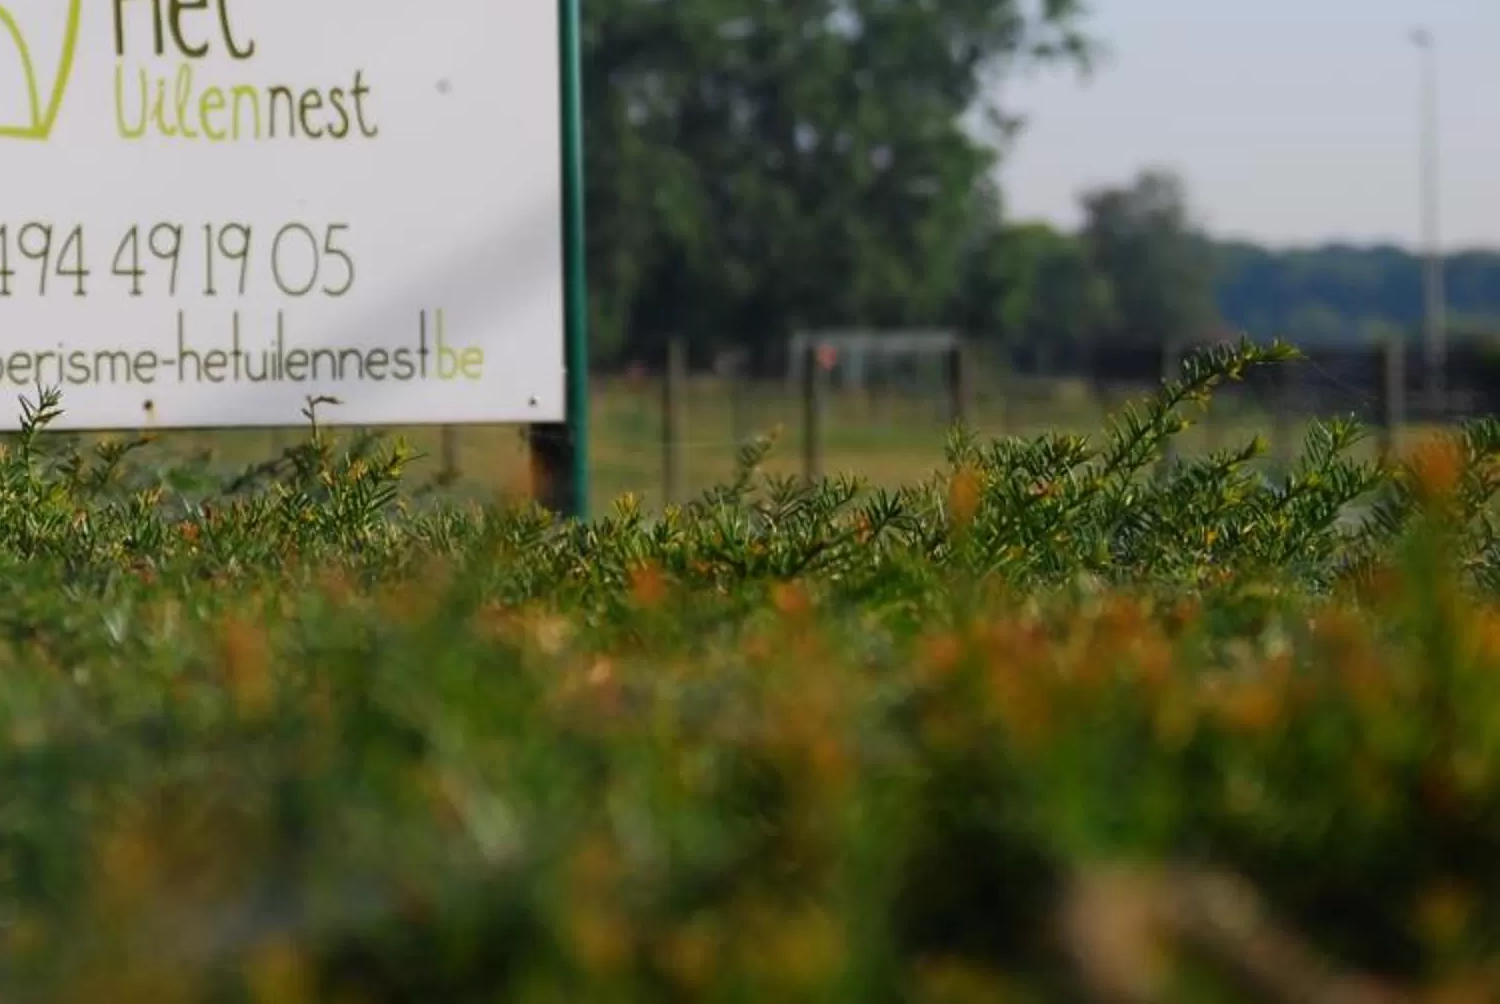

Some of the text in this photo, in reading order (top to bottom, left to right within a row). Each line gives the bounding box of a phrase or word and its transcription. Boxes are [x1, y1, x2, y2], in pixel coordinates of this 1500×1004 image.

[114, 62, 379, 140] Uilennest
[111, 222, 182, 297] 49
[202, 222, 252, 297] 19
[271, 222, 356, 297] 05
